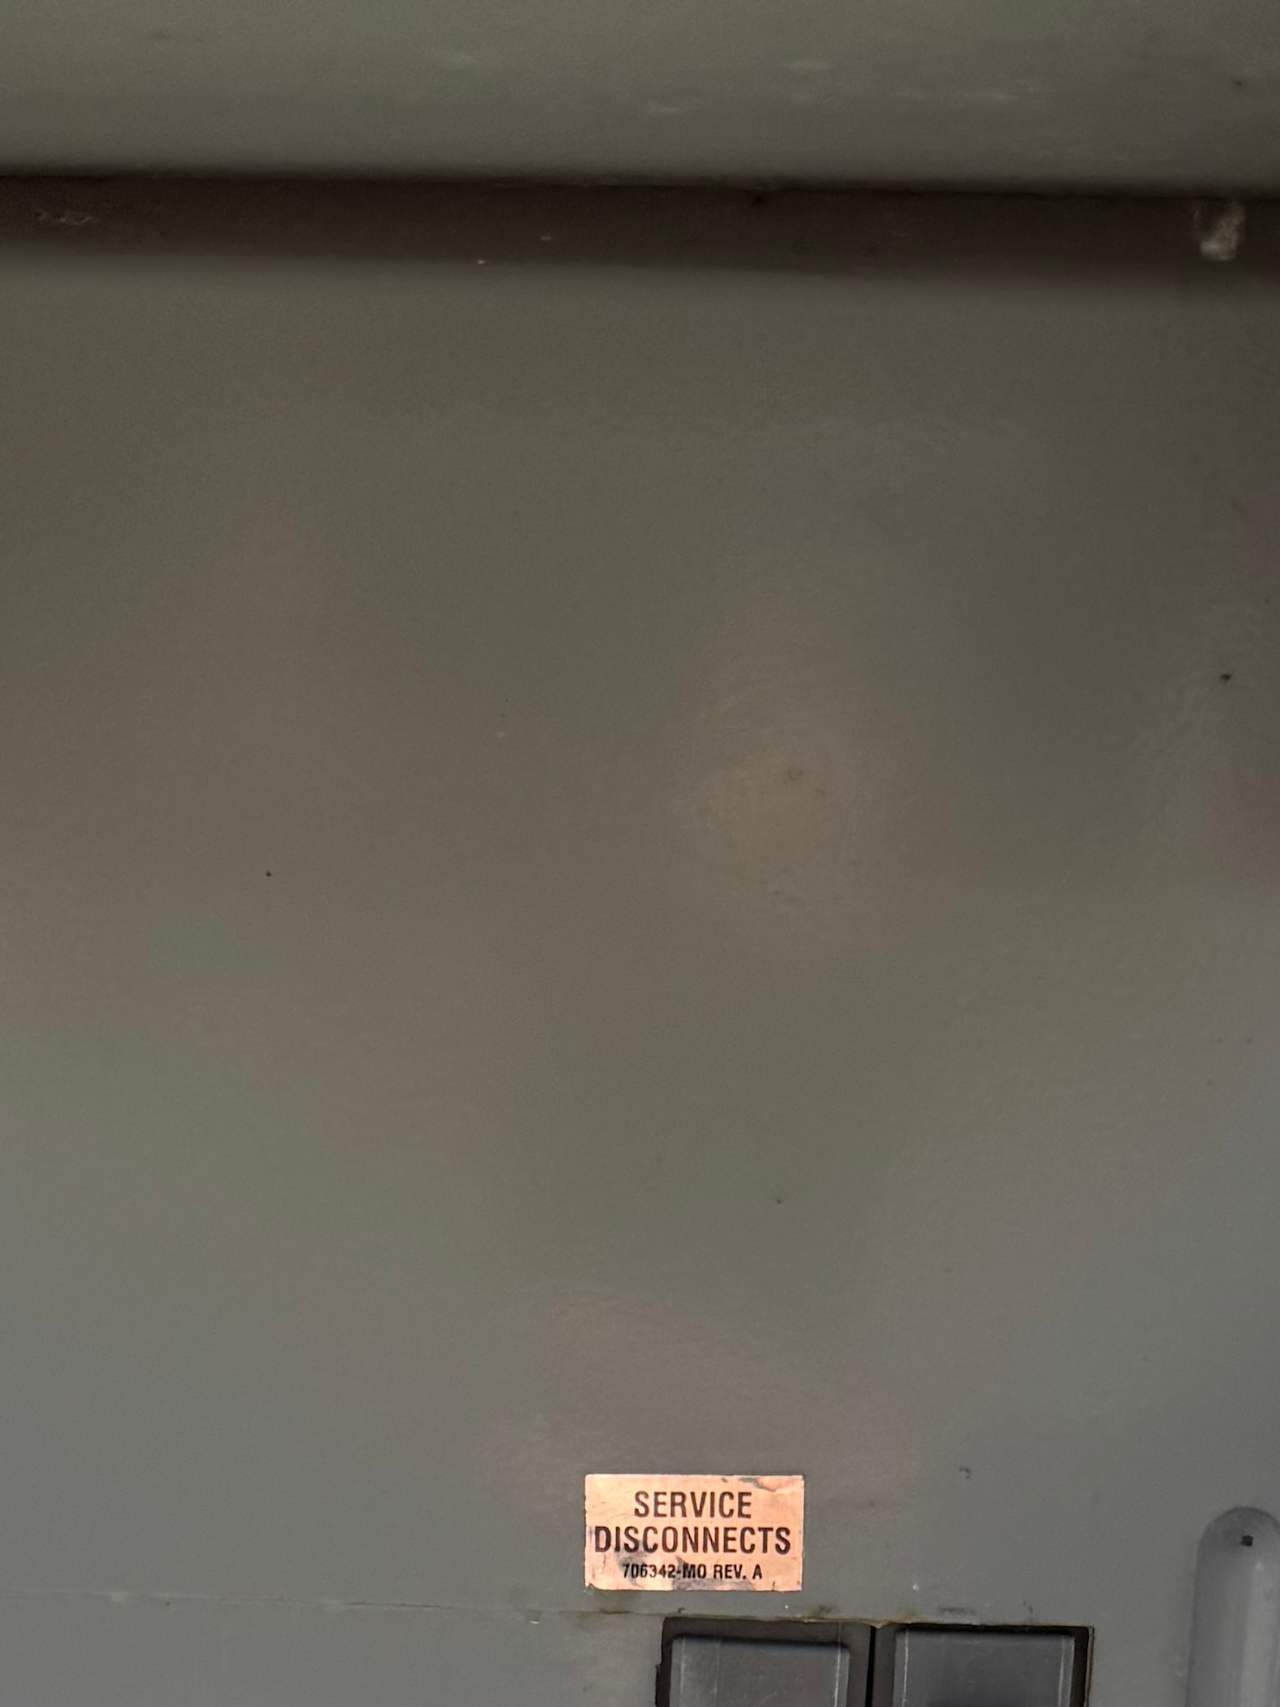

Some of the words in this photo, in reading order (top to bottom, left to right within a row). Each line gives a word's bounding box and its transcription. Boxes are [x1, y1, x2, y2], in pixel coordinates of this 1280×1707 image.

[634, 1490, 753, 1519] SERVICE
[594, 1525, 792, 1555] DISCONNECTS
[713, 1564, 747, 1580] REV.
[752, 1564, 763, 1580] A
